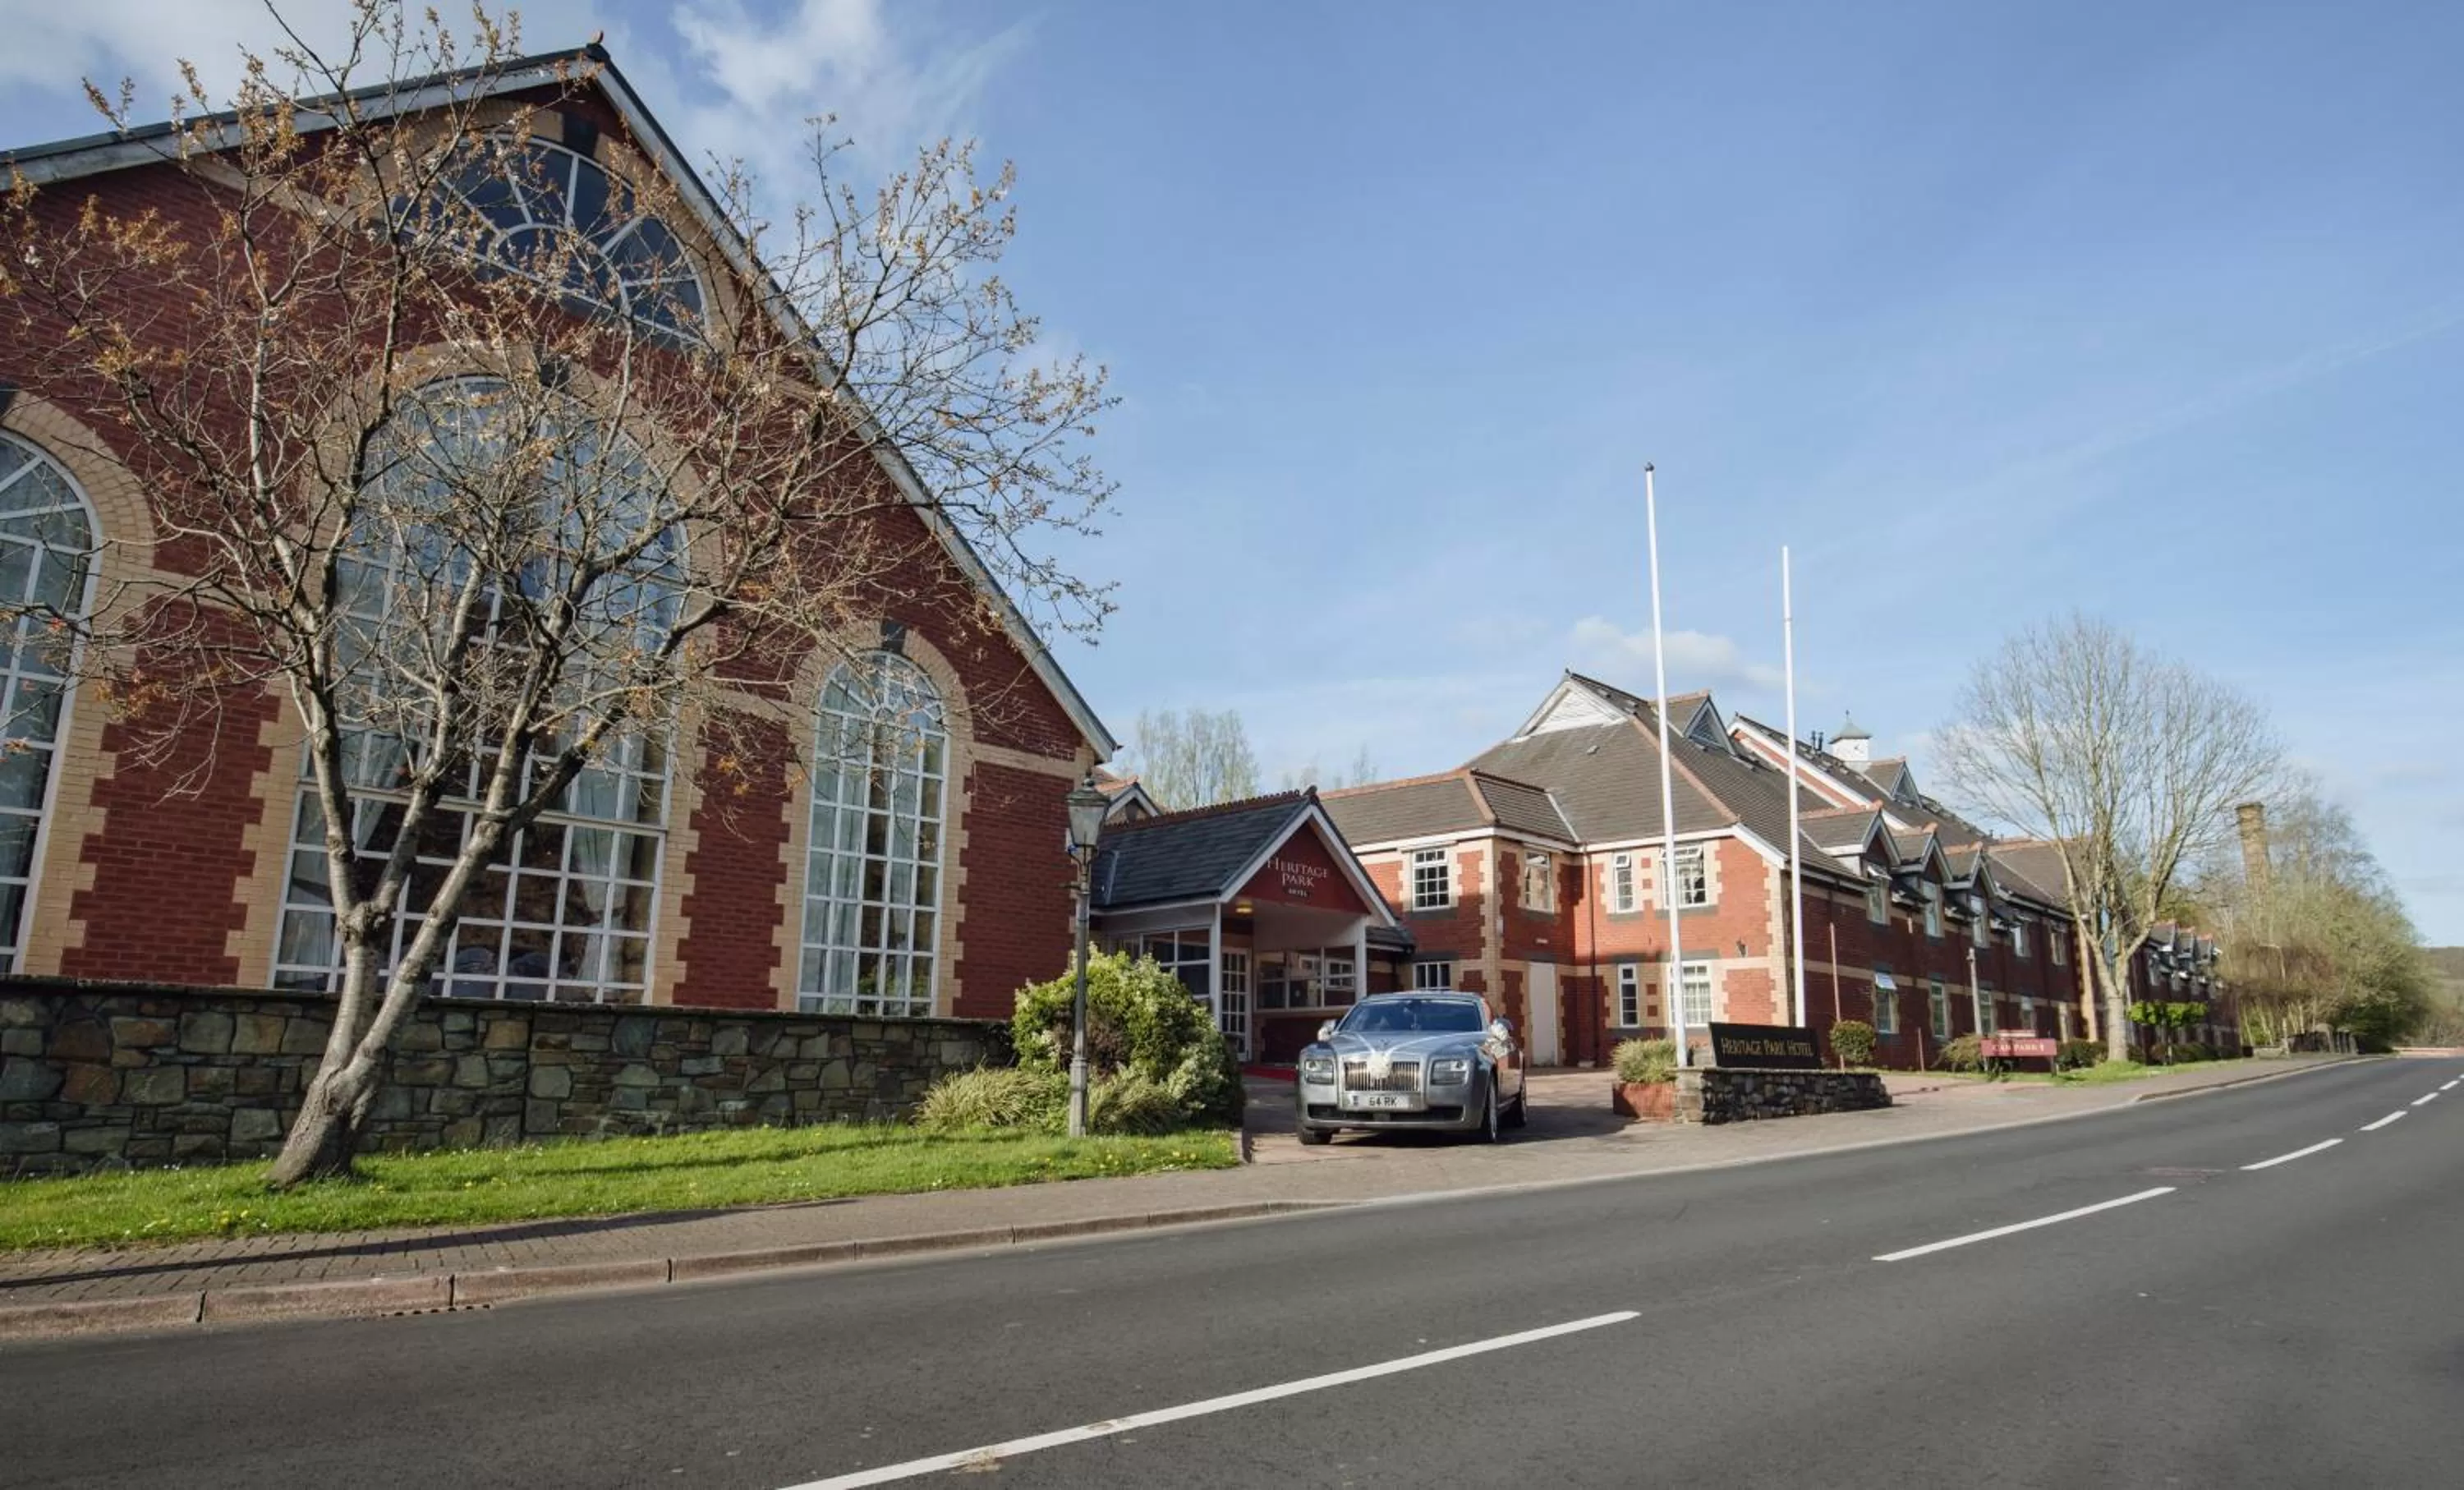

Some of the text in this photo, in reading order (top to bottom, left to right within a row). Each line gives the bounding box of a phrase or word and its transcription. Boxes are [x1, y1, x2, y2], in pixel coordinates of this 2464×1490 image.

[1267, 857, 1328, 878] HERITAGE
[1282, 872, 1314, 888] PARK
[1721, 1037, 1814, 1056] HERITAGE PARK HOTEL
